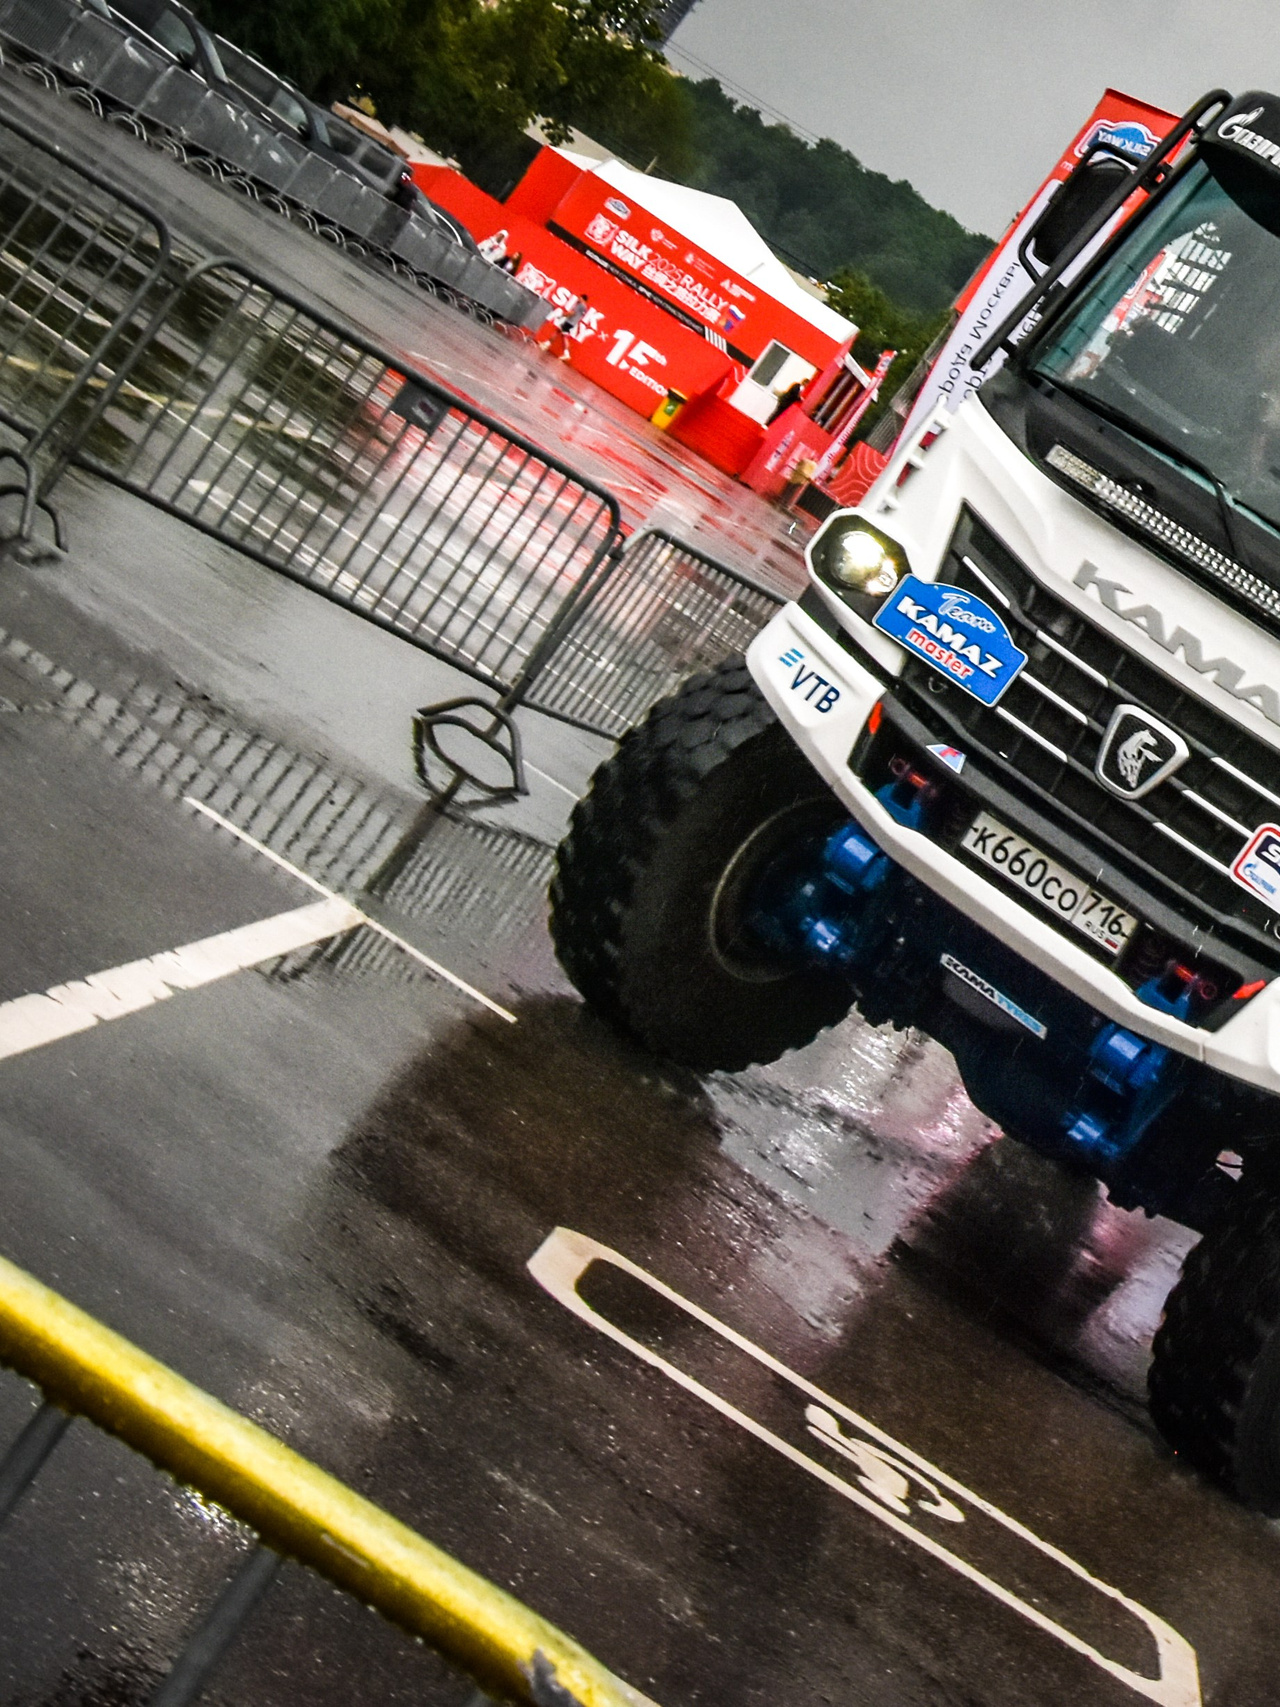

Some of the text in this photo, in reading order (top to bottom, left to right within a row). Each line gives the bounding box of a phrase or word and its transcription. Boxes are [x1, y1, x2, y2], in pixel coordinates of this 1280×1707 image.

[607, 240, 645, 271] WAY
[614, 229, 653, 260] SILK
[649, 252, 684, 281] 2025
[679, 273, 729, 312] RALLY
[551, 287, 605, 329] SIK
[896, 595, 1005, 679] KAMAZ
[940, 591, 998, 635] Team
[904, 627, 975, 680] master
[790, 663, 841, 714] VTB
[1081, 889, 1125, 938] 716
